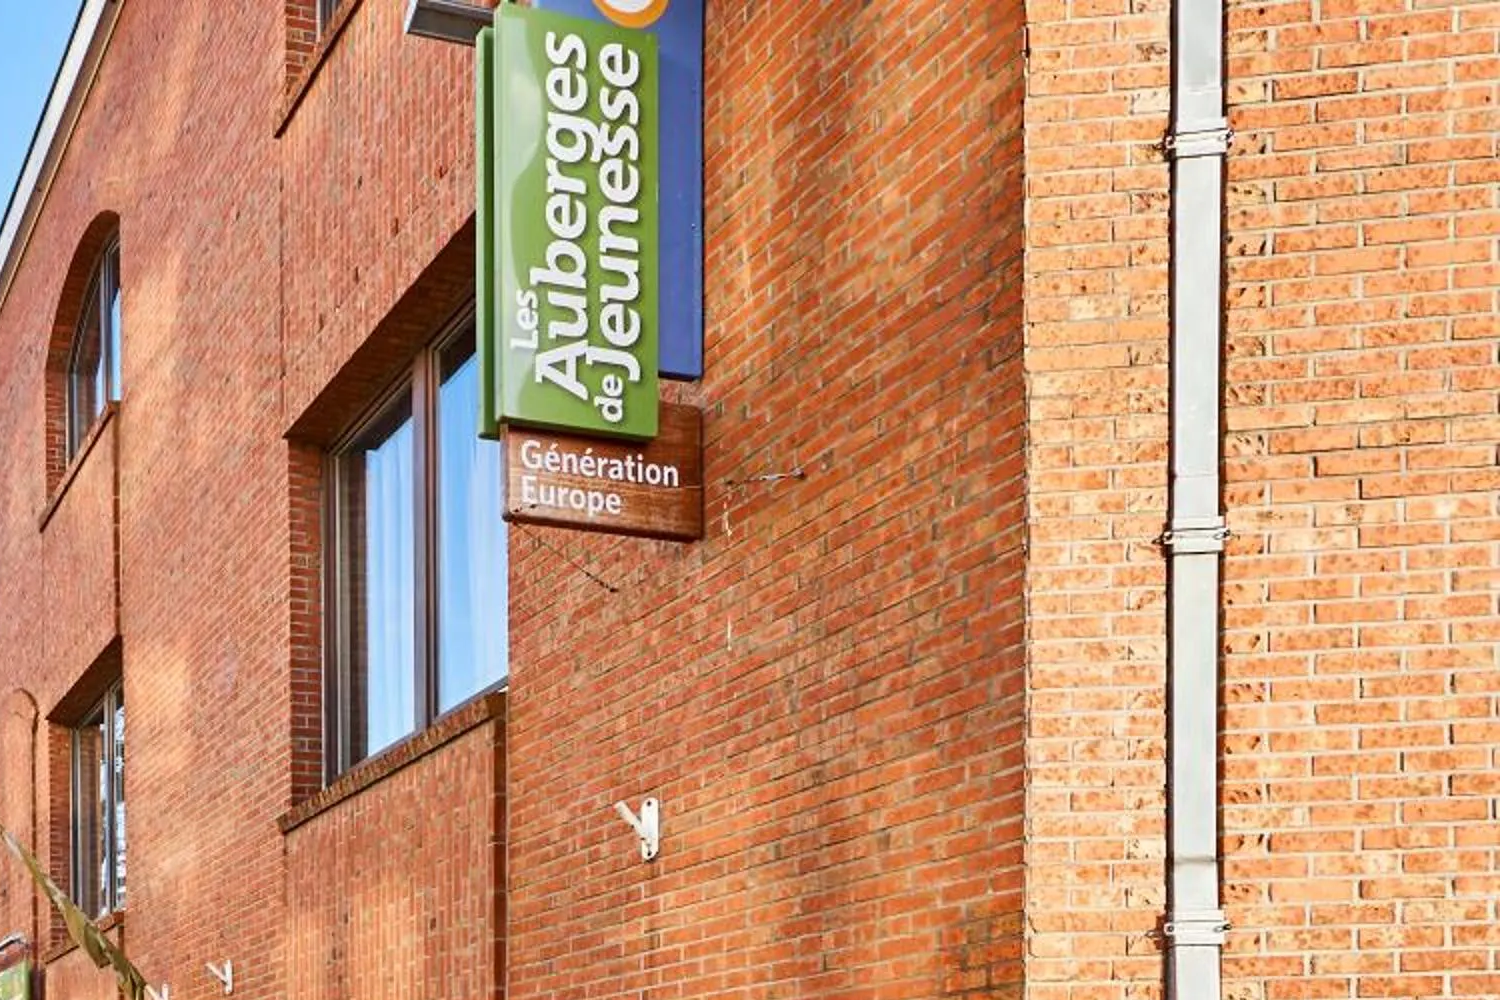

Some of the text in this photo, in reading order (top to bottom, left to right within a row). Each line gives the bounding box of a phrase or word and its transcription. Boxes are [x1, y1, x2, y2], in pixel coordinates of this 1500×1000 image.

[529, 31, 601, 401] Auberges
[585, 43, 640, 422] de Jeunesse
[510, 287, 539, 349] Les
[520, 439, 680, 488] Génération
[520, 475, 622, 517] Europe
